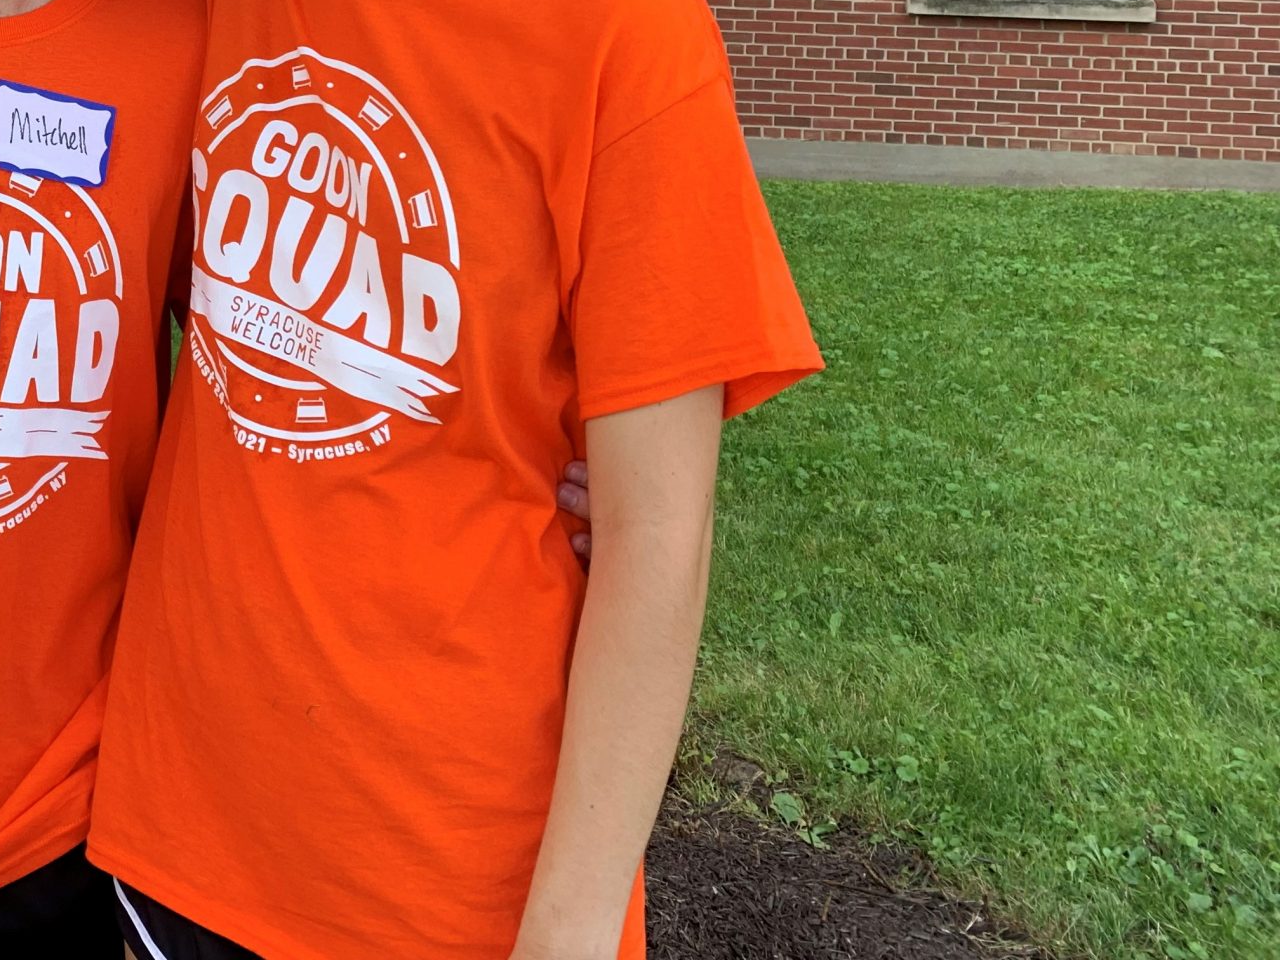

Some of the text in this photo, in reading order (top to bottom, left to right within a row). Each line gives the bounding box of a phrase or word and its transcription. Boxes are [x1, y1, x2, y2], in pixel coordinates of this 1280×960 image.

[9, 107, 87, 155] Mitchell
[251, 119, 373, 227] GOON
[230, 295, 325, 350] SYRACUSE
[230, 315, 317, 367] WELCOME
[288, 440, 370, 464] Syracuse,
[369, 424, 391, 446] NY
[49, 471, 66, 492] NY
